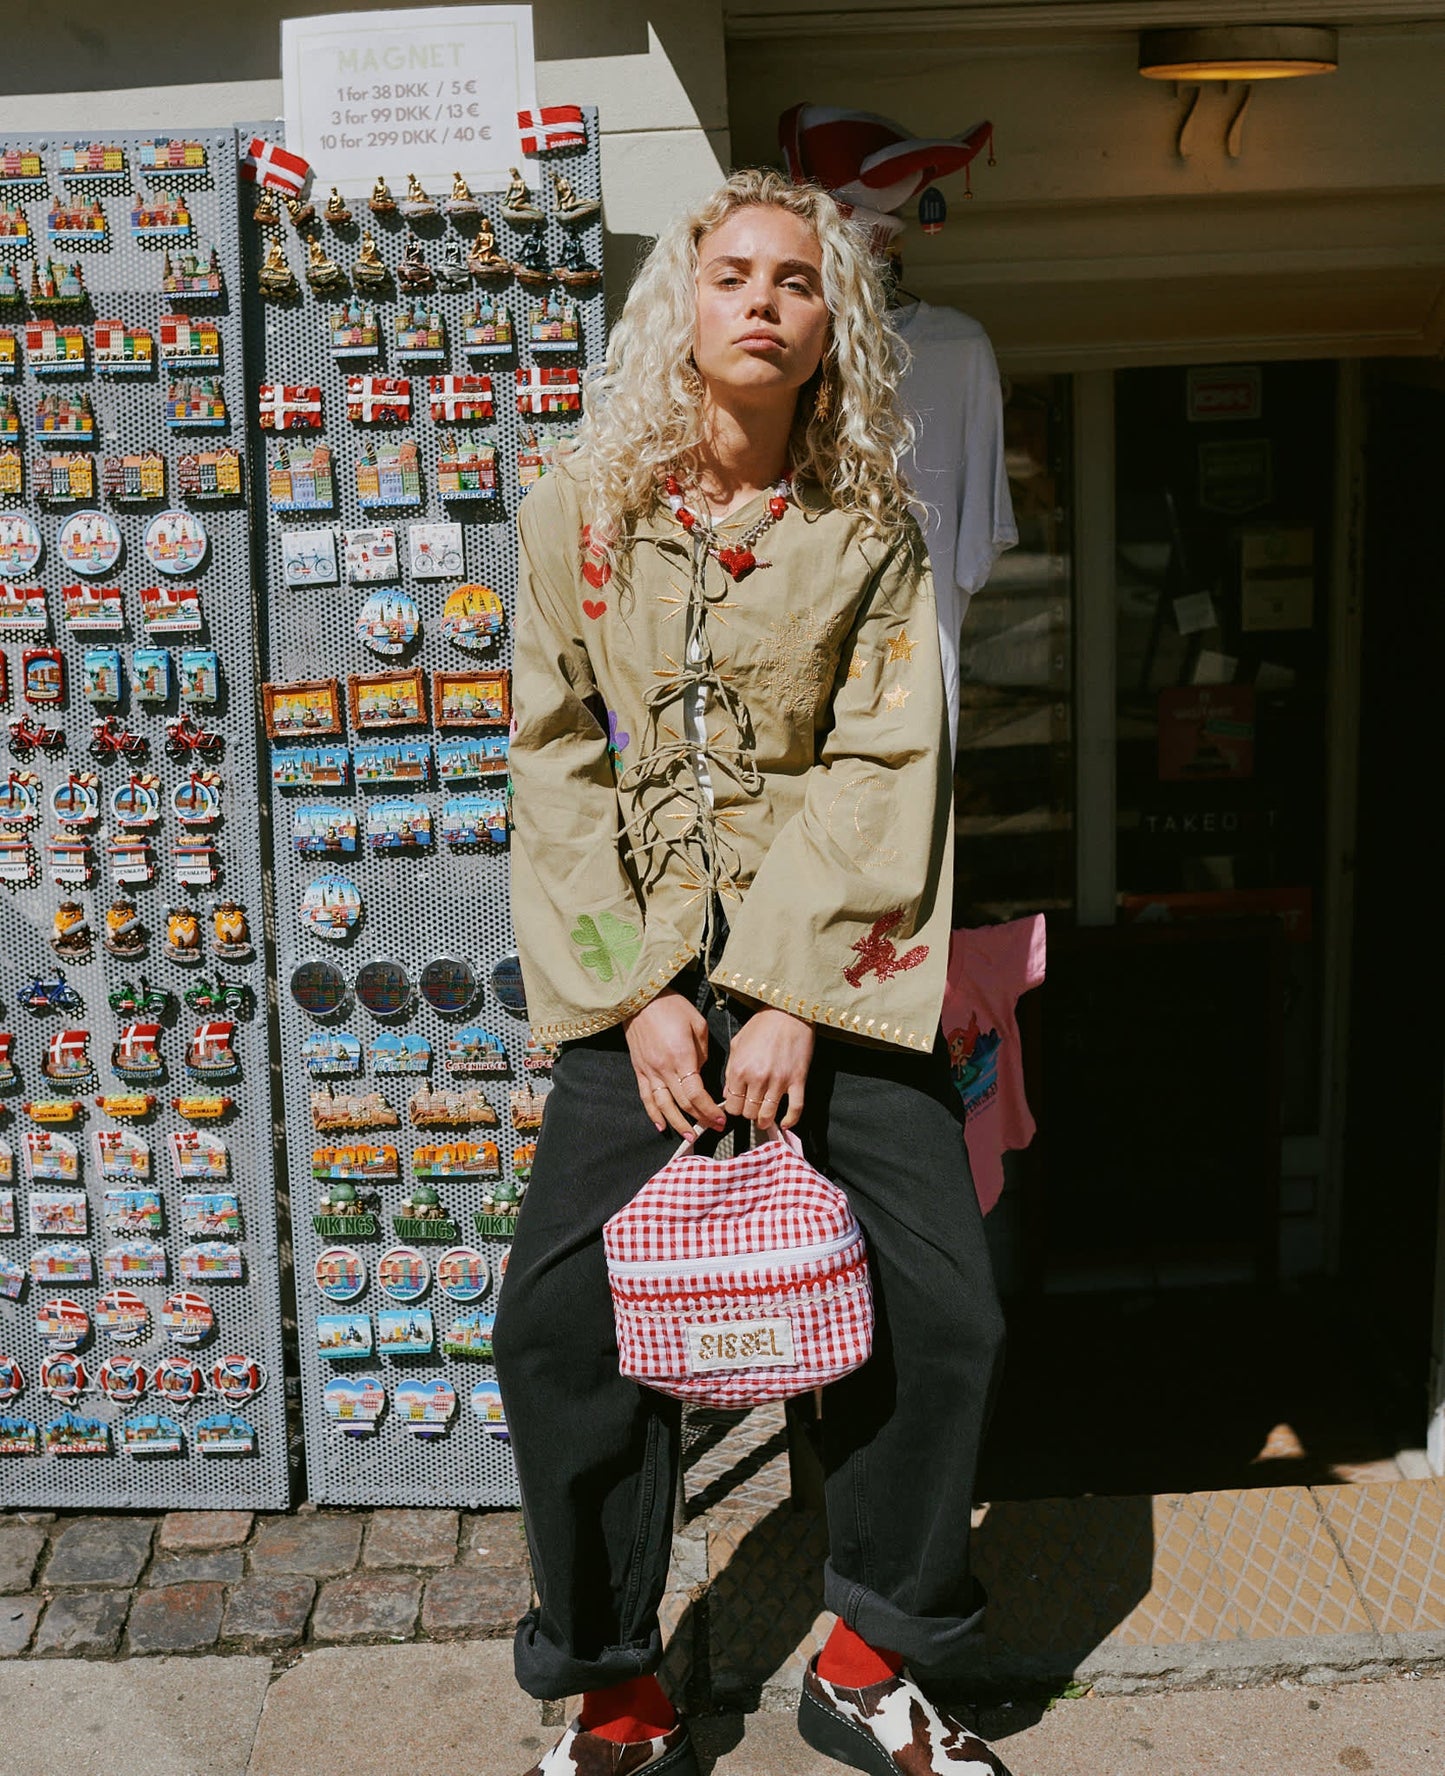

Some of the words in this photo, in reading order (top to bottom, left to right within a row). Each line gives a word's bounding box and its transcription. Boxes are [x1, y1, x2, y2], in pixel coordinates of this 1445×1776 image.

[337, 43, 465, 73] MAGNET
[337, 88, 344, 102] 1
[347, 86, 369, 102] for
[372, 85, 392, 100] 38
[395, 82, 429, 98] DKK
[436, 81, 444, 98] /
[451, 81, 461, 95] 5
[464, 80, 478, 95] €
[331, 111, 342, 126] 3
[344, 109, 369, 125] for
[371, 107, 392, 123] 99
[395, 104, 431, 122] DKK
[435, 104, 443, 121] /
[446, 103, 464, 119] 13
[466, 102, 480, 118] €
[320, 134, 338, 150] 10
[340, 133, 364, 149] for
[367, 131, 399, 147] 299
[402, 129, 437, 146] DKK
[441, 127, 450, 145] /
[453, 126, 475, 143] 40
[478, 125, 493, 141] €
[171, 291, 212, 299] COPENHAGEN
[42, 363, 84, 372] COPENHAGEN
[109, 364, 151, 372] COPENHAGEN
[176, 360, 219, 368] COPENHAGEN
[275, 500, 332, 510] COPENHAGEN
[363, 496, 419, 506] COPENHAGEN
[440, 491, 493, 500] COPENHAGEN
[1145, 810, 1278, 833] TAKEOT
[313, 1216, 376, 1235] VIKINGS
[393, 1219, 456, 1239] VIKINGS
[473, 1215, 517, 1236] VIKIN
[699, 1327, 784, 1360] SISSEL
